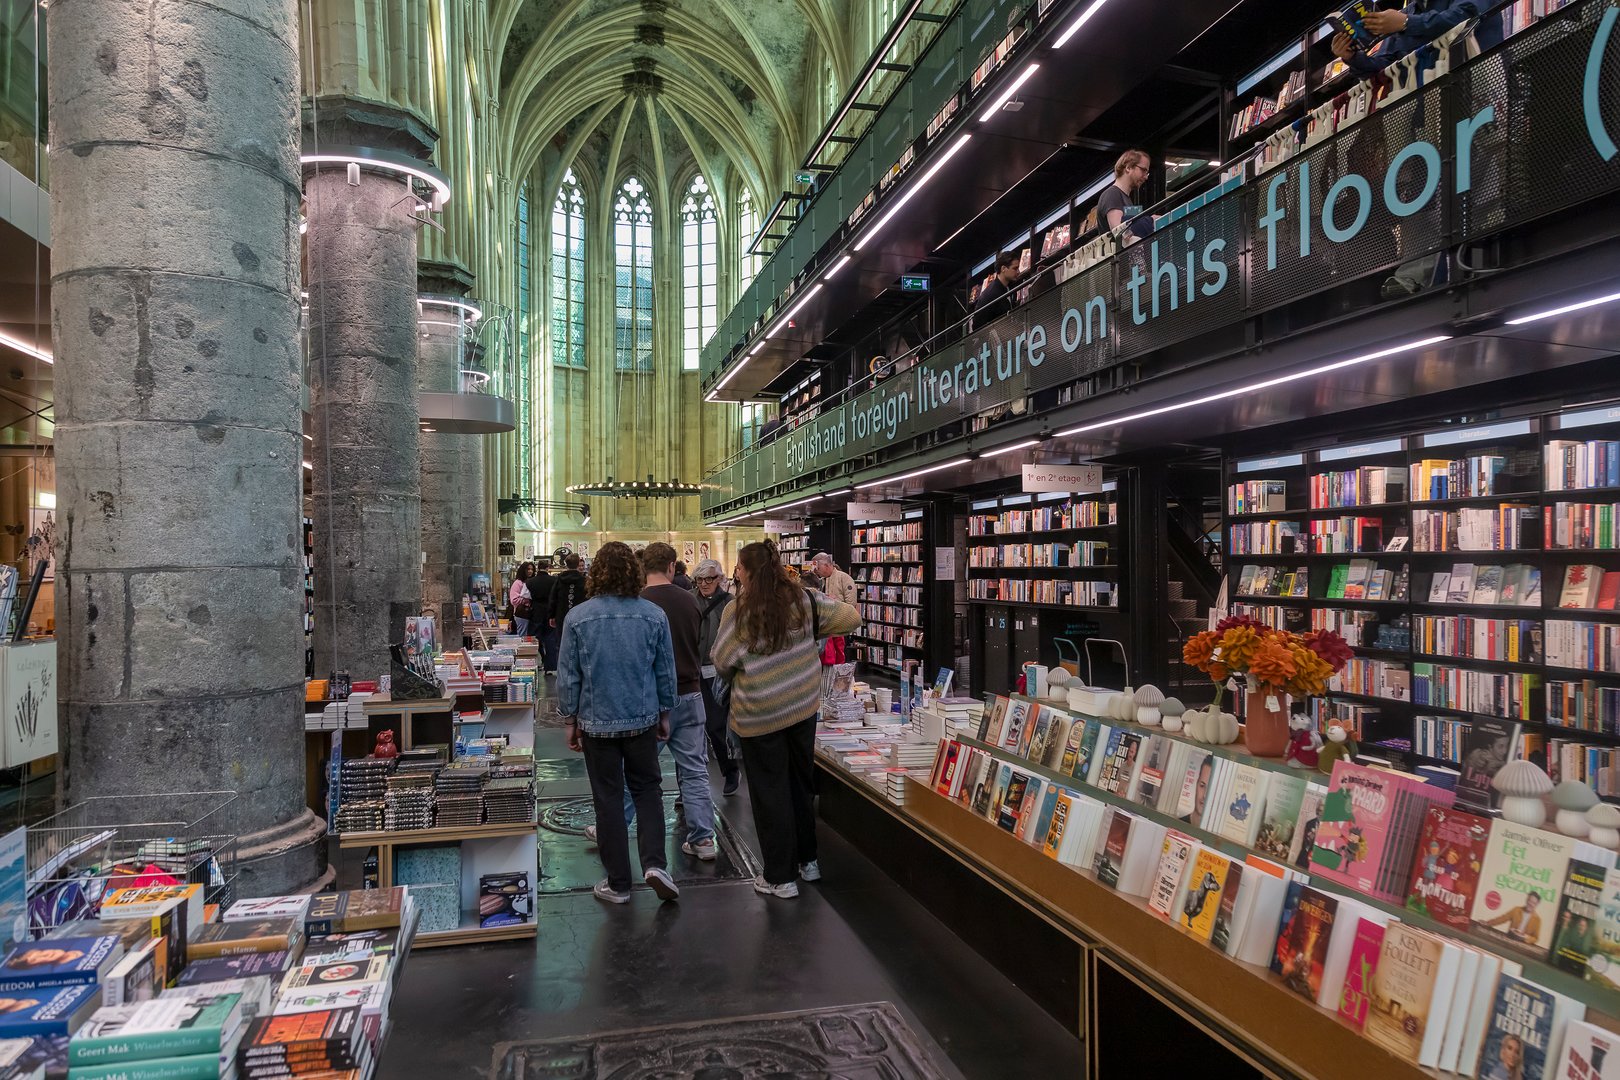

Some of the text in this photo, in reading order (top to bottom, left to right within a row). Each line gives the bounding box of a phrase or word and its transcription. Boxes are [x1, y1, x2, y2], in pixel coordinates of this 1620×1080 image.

[785, 420, 824, 472] English
[822, 407, 847, 453] and
[851, 389, 909, 440] foreign
[917, 323, 1047, 414] literature
[1060, 294, 1107, 353] on
[1127, 227, 1228, 325] this
[1259, 105, 1496, 272] floor
[1458, 429, 1491, 439] Literatuur
[1058, 474, 1081, 485] etage
[861, 507, 876, 515] toilet
[1352, 785, 1386, 815] PAARD
[1501, 829, 1564, 853] Jamie Oliver
[1502, 839, 1526, 860] Eet
[1508, 857, 1553, 884] jezelf
[1415, 877, 1467, 910] AVONTUUR
[1495, 873, 1556, 903] gezond
[220, 945, 257, 955] De Hanze
[1399, 932, 1424, 953] KEN
[1384, 940, 1434, 976] FOLLETT
[77, 1036, 202, 1058] Geert Mak Wisselwachter
